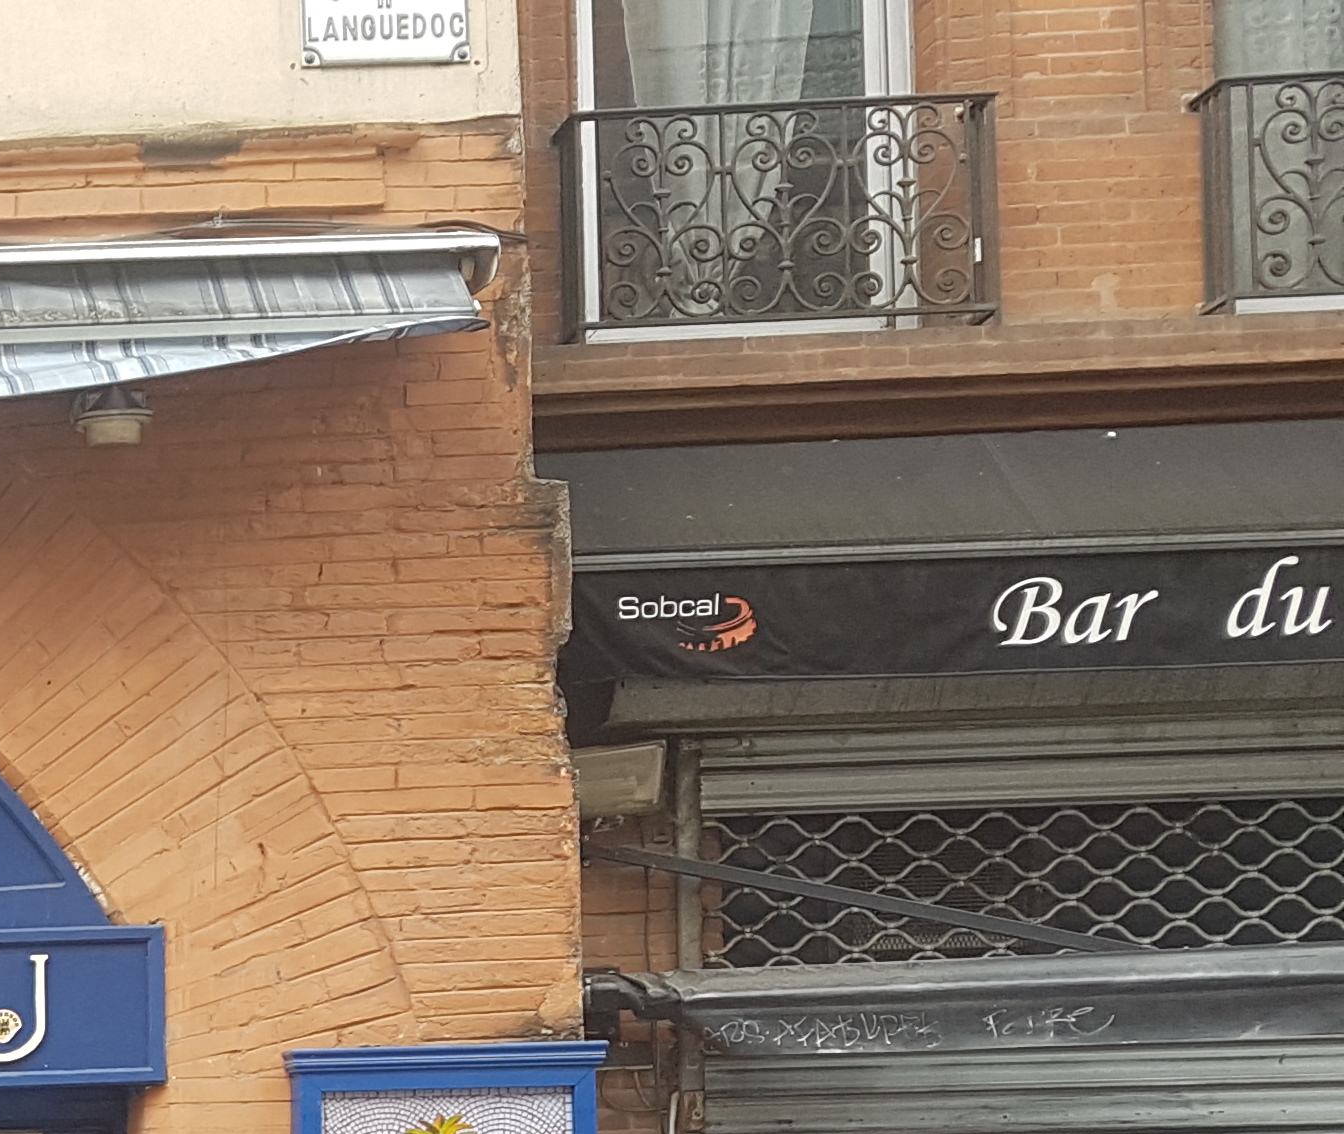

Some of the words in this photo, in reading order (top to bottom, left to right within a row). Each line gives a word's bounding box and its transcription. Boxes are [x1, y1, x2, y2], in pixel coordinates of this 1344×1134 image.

[307, 12, 465, 43] LANGUEDOC
[618, 593, 720, 619] Sobcal
[992, 576, 1159, 645] Bar
[1226, 555, 1333, 638] du
